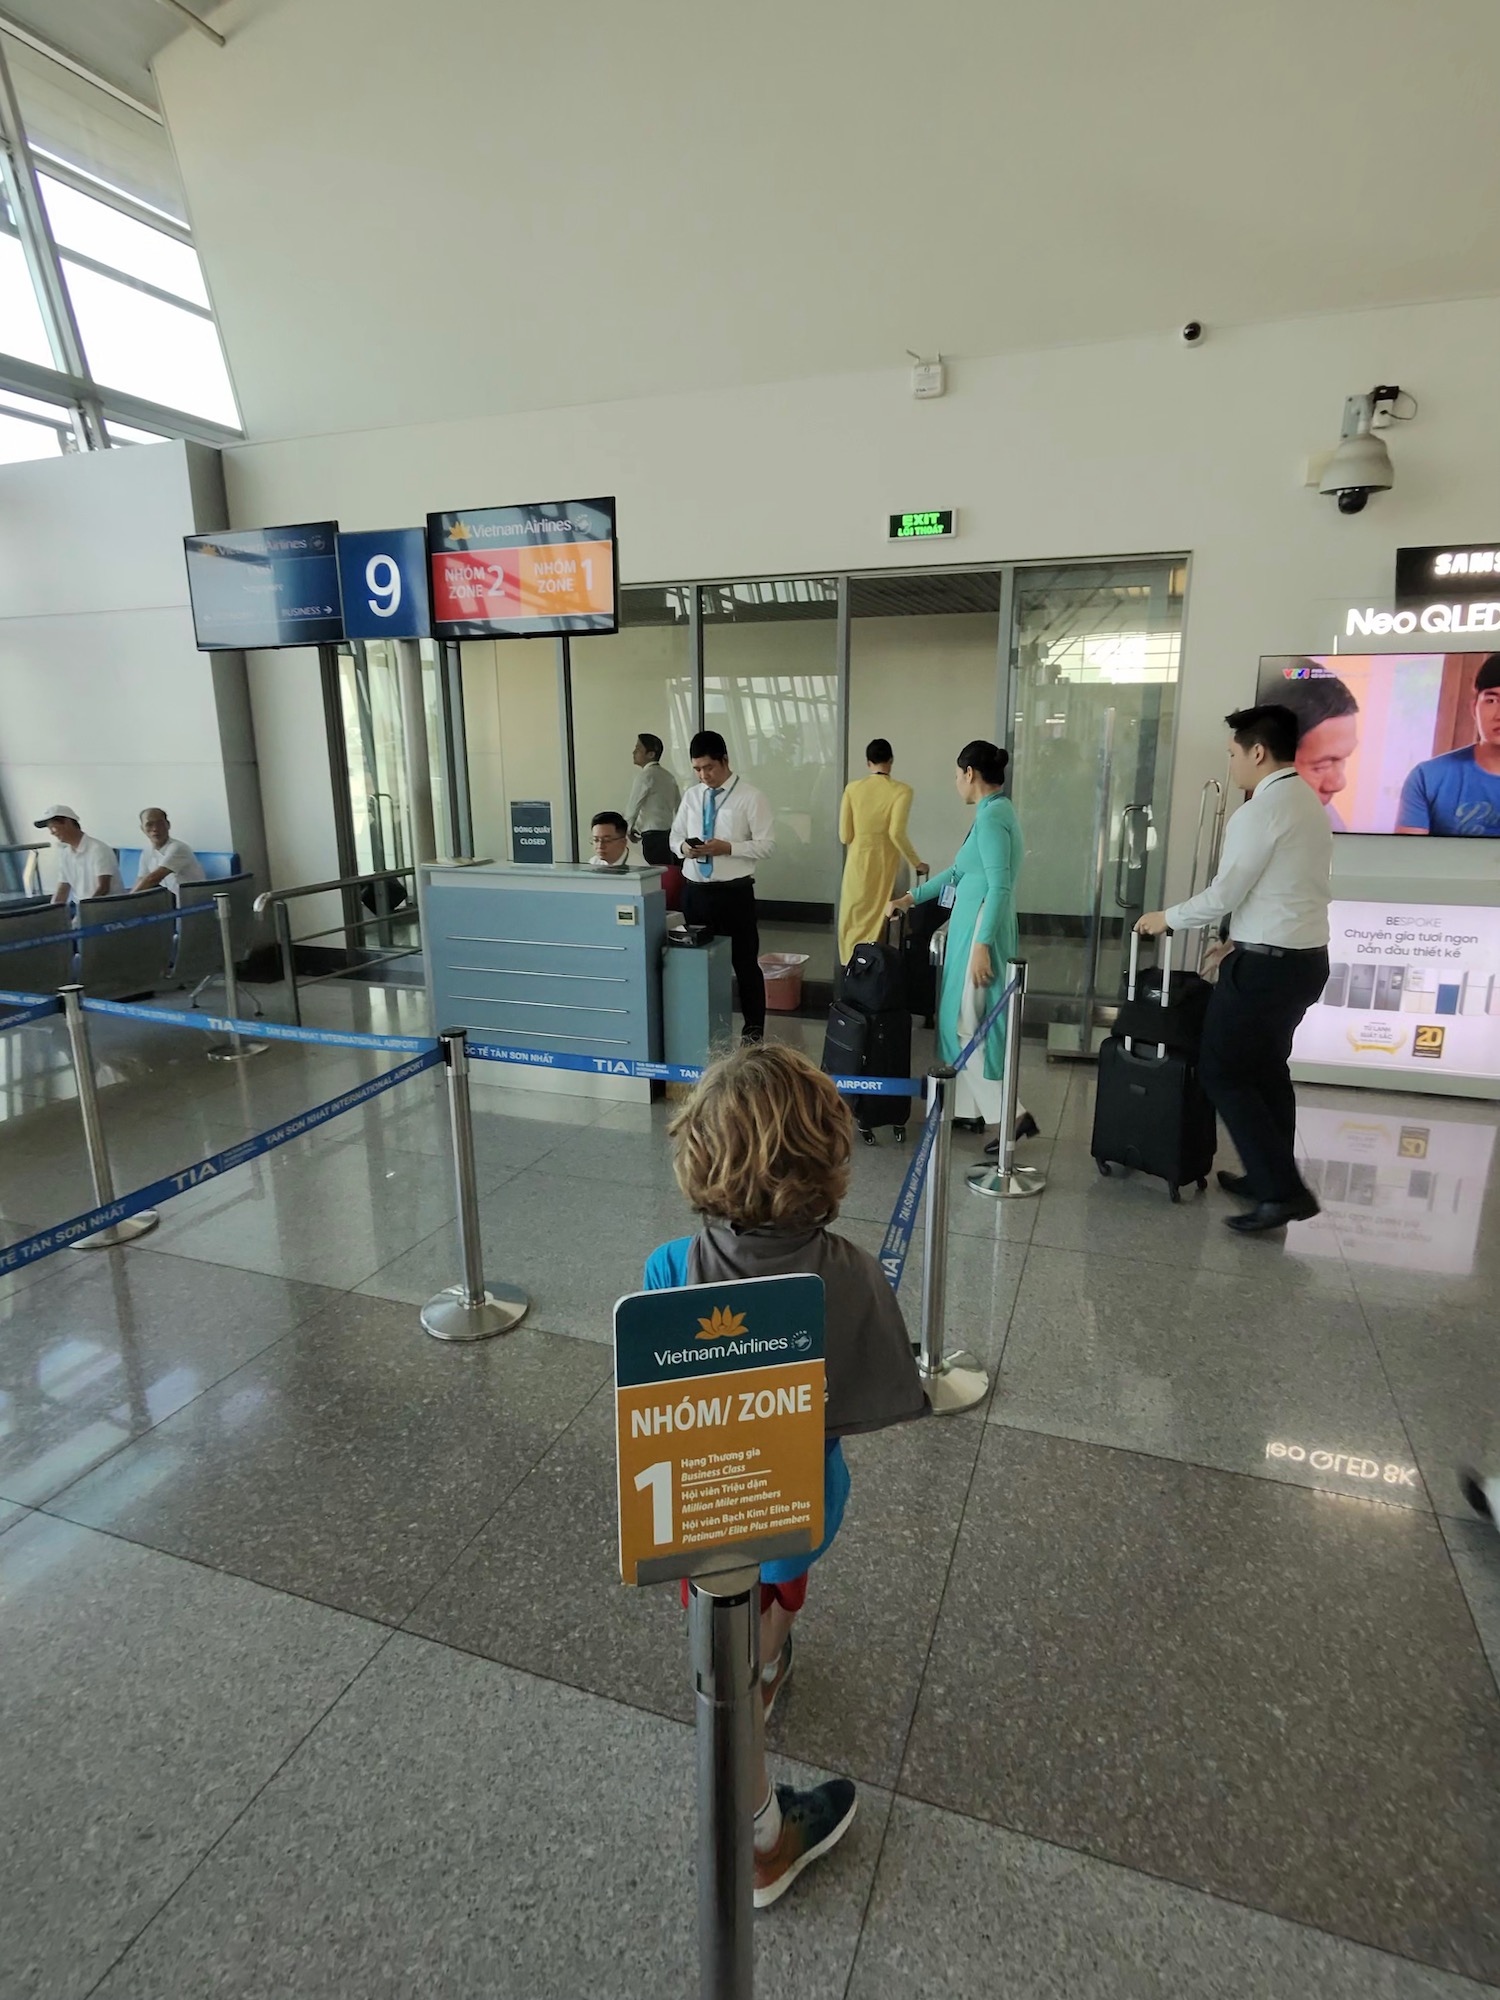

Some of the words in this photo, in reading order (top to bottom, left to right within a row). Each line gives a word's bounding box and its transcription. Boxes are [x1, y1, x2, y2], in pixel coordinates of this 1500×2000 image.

[472, 522, 524, 539] Vietnam
[524, 518, 572, 533] Airlines
[902, 512, 940, 526] EXIT
[445, 565, 486, 582] NHÓM
[533, 558, 576, 576] NHÓM
[581, 558, 593, 591] 1
[365, 554, 401, 618] 9
[487, 565, 505, 597] 2
[538, 578, 574, 593] ZONE
[449, 585, 483, 599] ZONE
[1346, 607, 1417, 636] Neo
[520, 838, 546, 846] CLOSED
[1386, 916, 1442, 928] BESPOKE
[1344, 929, 1392, 941] Chuyên
[1395, 931, 1415, 943] gia
[1444, 934, 1478, 946] ngon
[1413, 945, 1442, 957] thiết
[1445, 946, 1462, 958] kế
[207, 1018, 236, 1031] TIA
[382, 1037, 420, 1049] AIRPORT
[1416, 1026, 1443, 1047] 20
[477, 1046, 489, 1056] TẾ
[490, 1049, 508, 1058] TÂN
[510, 1051, 528, 1060] SƠN
[530, 1053, 554, 1063] NHẤT
[593, 1059, 629, 1074] TIA
[680, 1069, 699, 1078] TAN
[836, 1080, 883, 1090] AIRPORT
[265, 1131, 285, 1144] TAN
[286, 1119, 305, 1136] SON
[307, 1108, 330, 1125] NHAT
[331, 1076, 392, 1112] INTERNATIONAL
[394, 1060, 424, 1080] AIRPORT
[170, 1162, 217, 1190] TIA
[20, 1237, 52, 1258] TÂN
[55, 1220, 87, 1243] SƠN
[882, 1259, 901, 1288] IA
[654, 1345, 725, 1366] Vietnam
[726, 1337, 788, 1356] Airlines
[631, 1395, 732, 1438] NHÓM/
[738, 1384, 812, 1422] ZONE
[681, 1457, 707, 1469] Hạng
[708, 1451, 745, 1463] Thương
[746, 1448, 761, 1459] gia
[681, 1468, 720, 1482] Business
[722, 1464, 746, 1475] Class
[681, 1490, 698, 1501] Hội
[700, 1486, 720, 1497] viên
[721, 1483, 745, 1493] Triệu
[634, 1461, 673, 1546] 1
[682, 1502, 713, 1514] Million
[715, 1497, 739, 1508] Miler
[740, 1490, 781, 1504] members
[682, 1520, 699, 1531] Hội
[700, 1516, 720, 1527] viên
[722, 1511, 745, 1524] Bạch
[747, 1508, 768, 1519] Kim/
[770, 1503, 790, 1514] Elite
[792, 1501, 811, 1511] Plus
[682, 1527, 728, 1544] Platinum/
[728, 1524, 748, 1536] Elite
[750, 1521, 769, 1532] Plus
[770, 1514, 811, 1528] members
